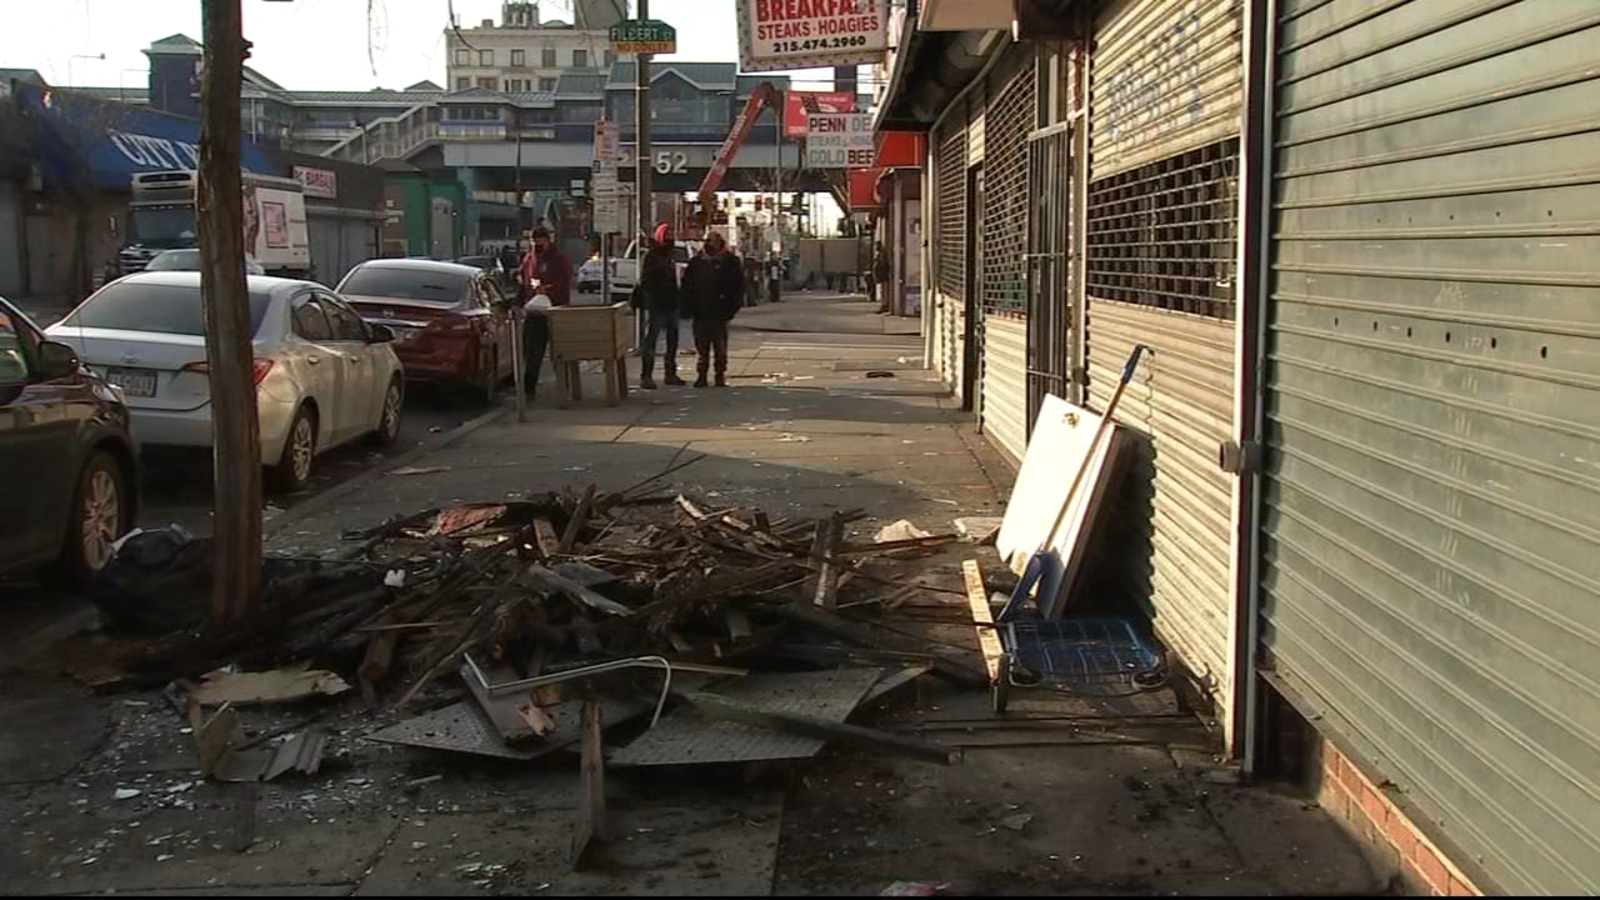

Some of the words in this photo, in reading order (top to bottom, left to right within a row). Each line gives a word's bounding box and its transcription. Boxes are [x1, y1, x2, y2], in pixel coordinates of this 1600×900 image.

[757, 21, 811, 40] STEAKS
[819, 15, 879, 35] HOAGIES
[773, 35, 866, 53] 215.474.2960
[809, 117, 846, 132] PENN
[851, 116, 872, 132] DE
[110, 132, 189, 170] CITY
[656, 150, 688, 175] 52
